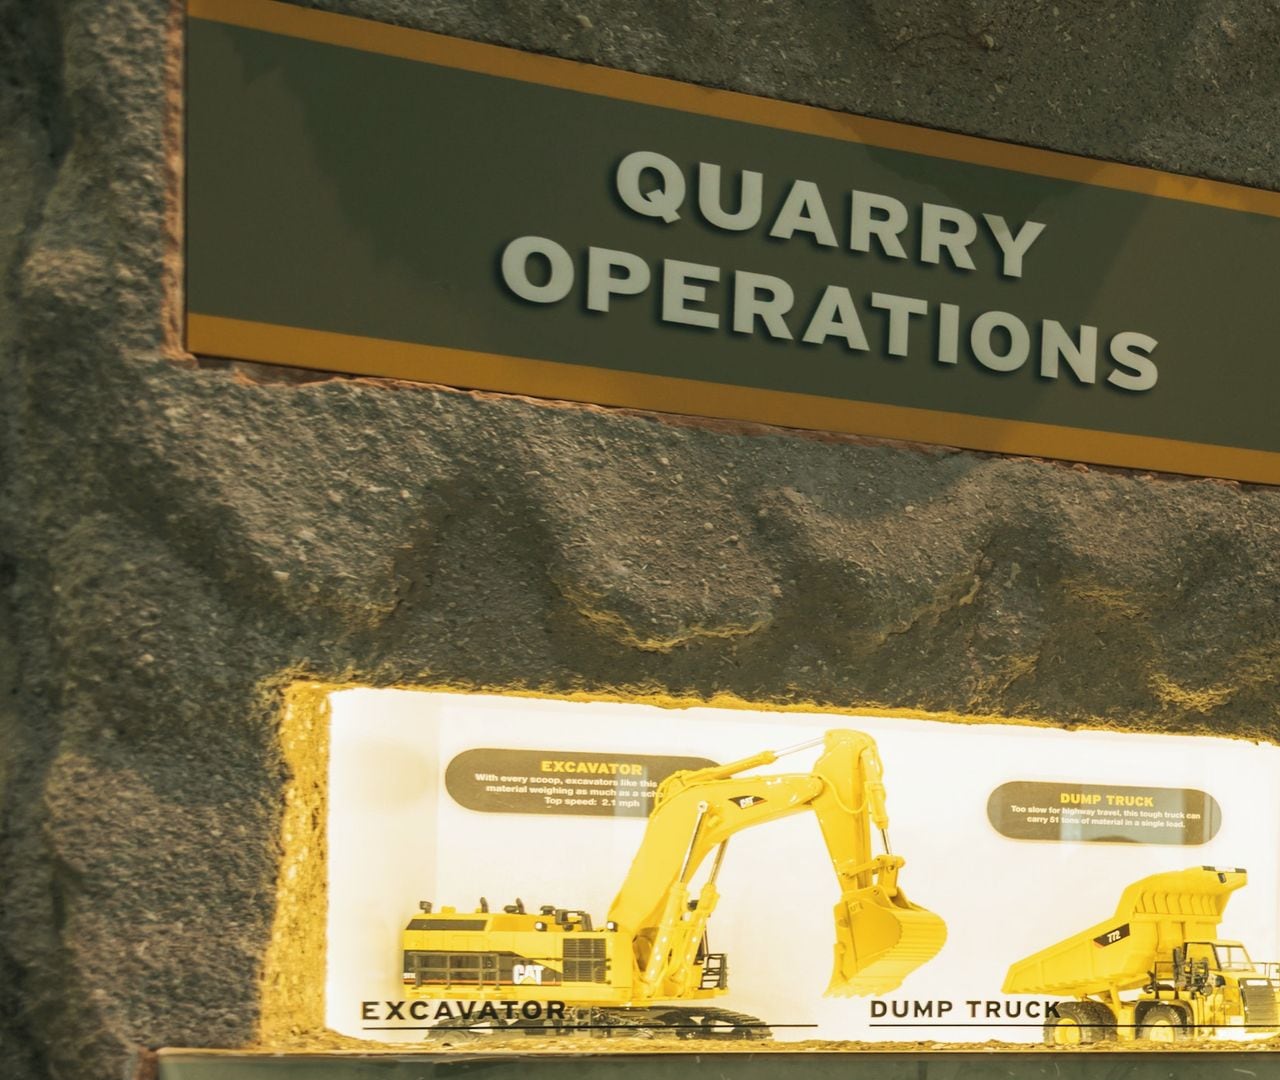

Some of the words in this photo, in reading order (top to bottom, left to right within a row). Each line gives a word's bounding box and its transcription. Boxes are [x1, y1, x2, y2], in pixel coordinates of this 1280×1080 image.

[615, 150, 1046, 279] QUARRY
[501, 235, 1159, 392] OPERATIONS
[541, 760, 643, 776] EXCAVATOR
[474, 773, 499, 782] With
[500, 775, 528, 784] every
[529, 777, 564, 785] scoop,
[564, 778, 618, 787] excavators
[620, 779, 638, 787] like
[640, 780, 658, 788] this
[486, 785, 528, 793] material
[529, 786, 574, 796] weighing
[590, 788, 616, 796] much
[544, 796, 563, 805] Top
[564, 797, 598, 806] speed:
[618, 799, 640, 808] mph
[1060, 792, 1102, 805] DUMP
[1105, 794, 1154, 807] TRUCK
[1011, 805, 1026, 813] Too
[1048, 806, 1060, 814] for
[1164, 811, 1185, 819] truck
[512, 963, 545, 986] CAT
[361, 1000, 567, 1022] EXCAVATOR
[870, 1000, 954, 1019] DUMP
[966, 1000, 1062, 1019] TRUCK
